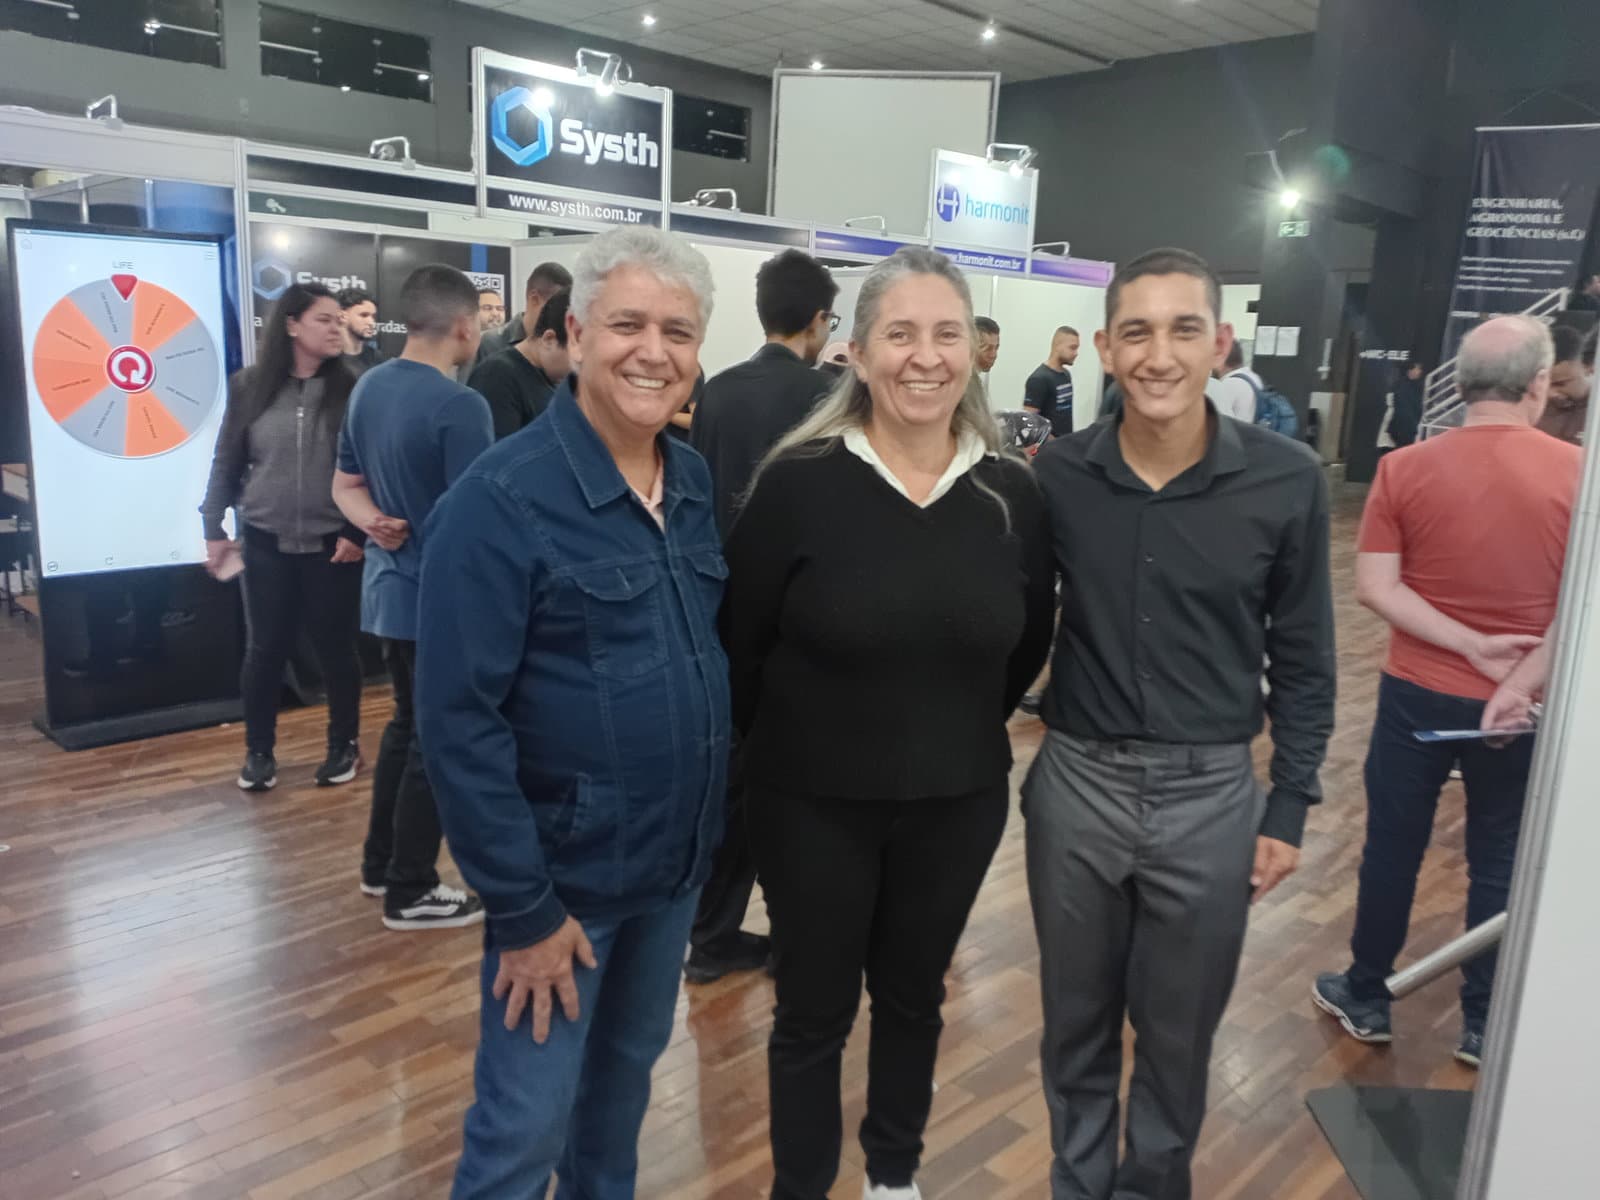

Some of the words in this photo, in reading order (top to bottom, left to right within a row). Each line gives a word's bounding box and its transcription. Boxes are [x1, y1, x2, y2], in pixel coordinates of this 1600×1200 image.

[560, 118, 658, 167] Systh
[508, 193, 642, 223] www.systh.com.br
[965, 193, 1029, 224] harmonit
